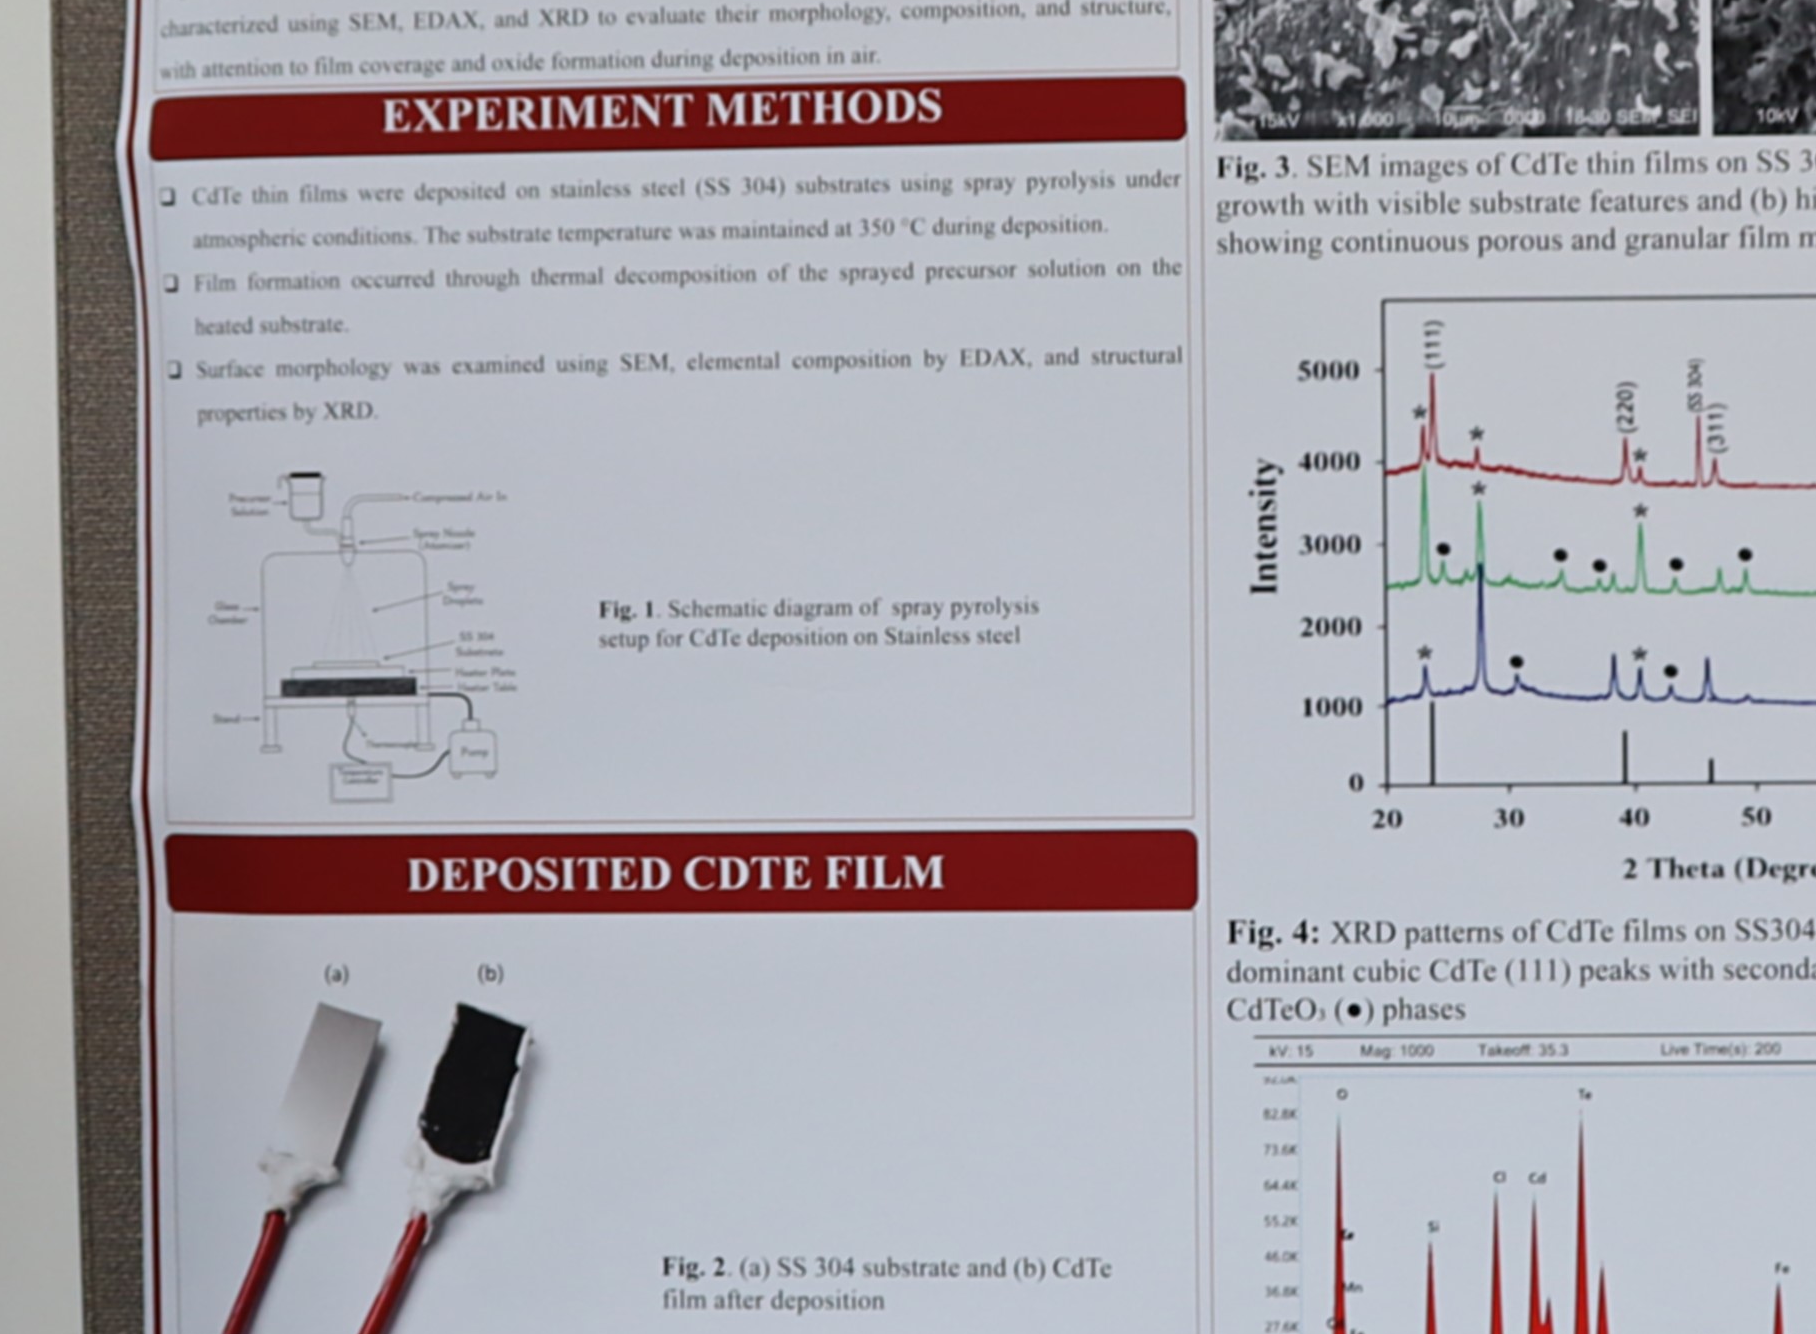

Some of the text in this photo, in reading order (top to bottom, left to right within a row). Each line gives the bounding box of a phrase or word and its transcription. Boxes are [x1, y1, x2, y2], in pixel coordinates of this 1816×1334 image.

[385, 88, 944, 135] EXPERIMENT METHODS
[1217, 230, 1324, 261] showing
[1331, 234, 1471, 256] continuous
[1478, 235, 1565, 260] porous
[1571, 226, 1618, 253] and
[1625, 226, 1731, 259] granular
[1740, 224, 1791, 251] film
[195, 315, 350, 338] heated substrate.
[1424, 319, 1445, 370] (111)
[1299, 359, 1361, 383] 5000
[1616, 380, 1638, 434] (220)
[1707, 402, 1729, 454] (311)
[1299, 452, 1362, 473] 4000
[1248, 457, 1285, 596] Intensity
[1300, 534, 1363, 557] 3000
[599, 600, 639, 626] Fig.
[668, 599, 768, 620] Schematic
[774, 598, 855, 624] diagram
[859, 597, 883, 618] of
[892, 602, 945, 623] spray
[951, 595, 1041, 623] pyrolysis
[1301, 616, 1364, 640] 2000
[1304, 698, 1364, 720] 1000
[1373, 809, 1405, 832] 20
[1494, 808, 1527, 831] 30
[1619, 807, 1652, 829] 40
[1742, 806, 1774, 829] 50
[410, 856, 944, 894] DEPOSITED CDTE FILM
[1624, 857, 1639, 881] 2
[1648, 856, 1726, 881] Theta
[324, 965, 351, 988] (a)
[478, 964, 506, 987] (b)
[663, 1255, 707, 1283] Fig.
[740, 1259, 772, 1282] (a)
[778, 1257, 809, 1279] SS
[817, 1256, 856, 1279] 304
[863, 1256, 961, 1279] substrate
[967, 1257, 1008, 1280] and
[1014, 1257, 1048, 1283] (b)
[1053, 1257, 1113, 1281] CdTe
